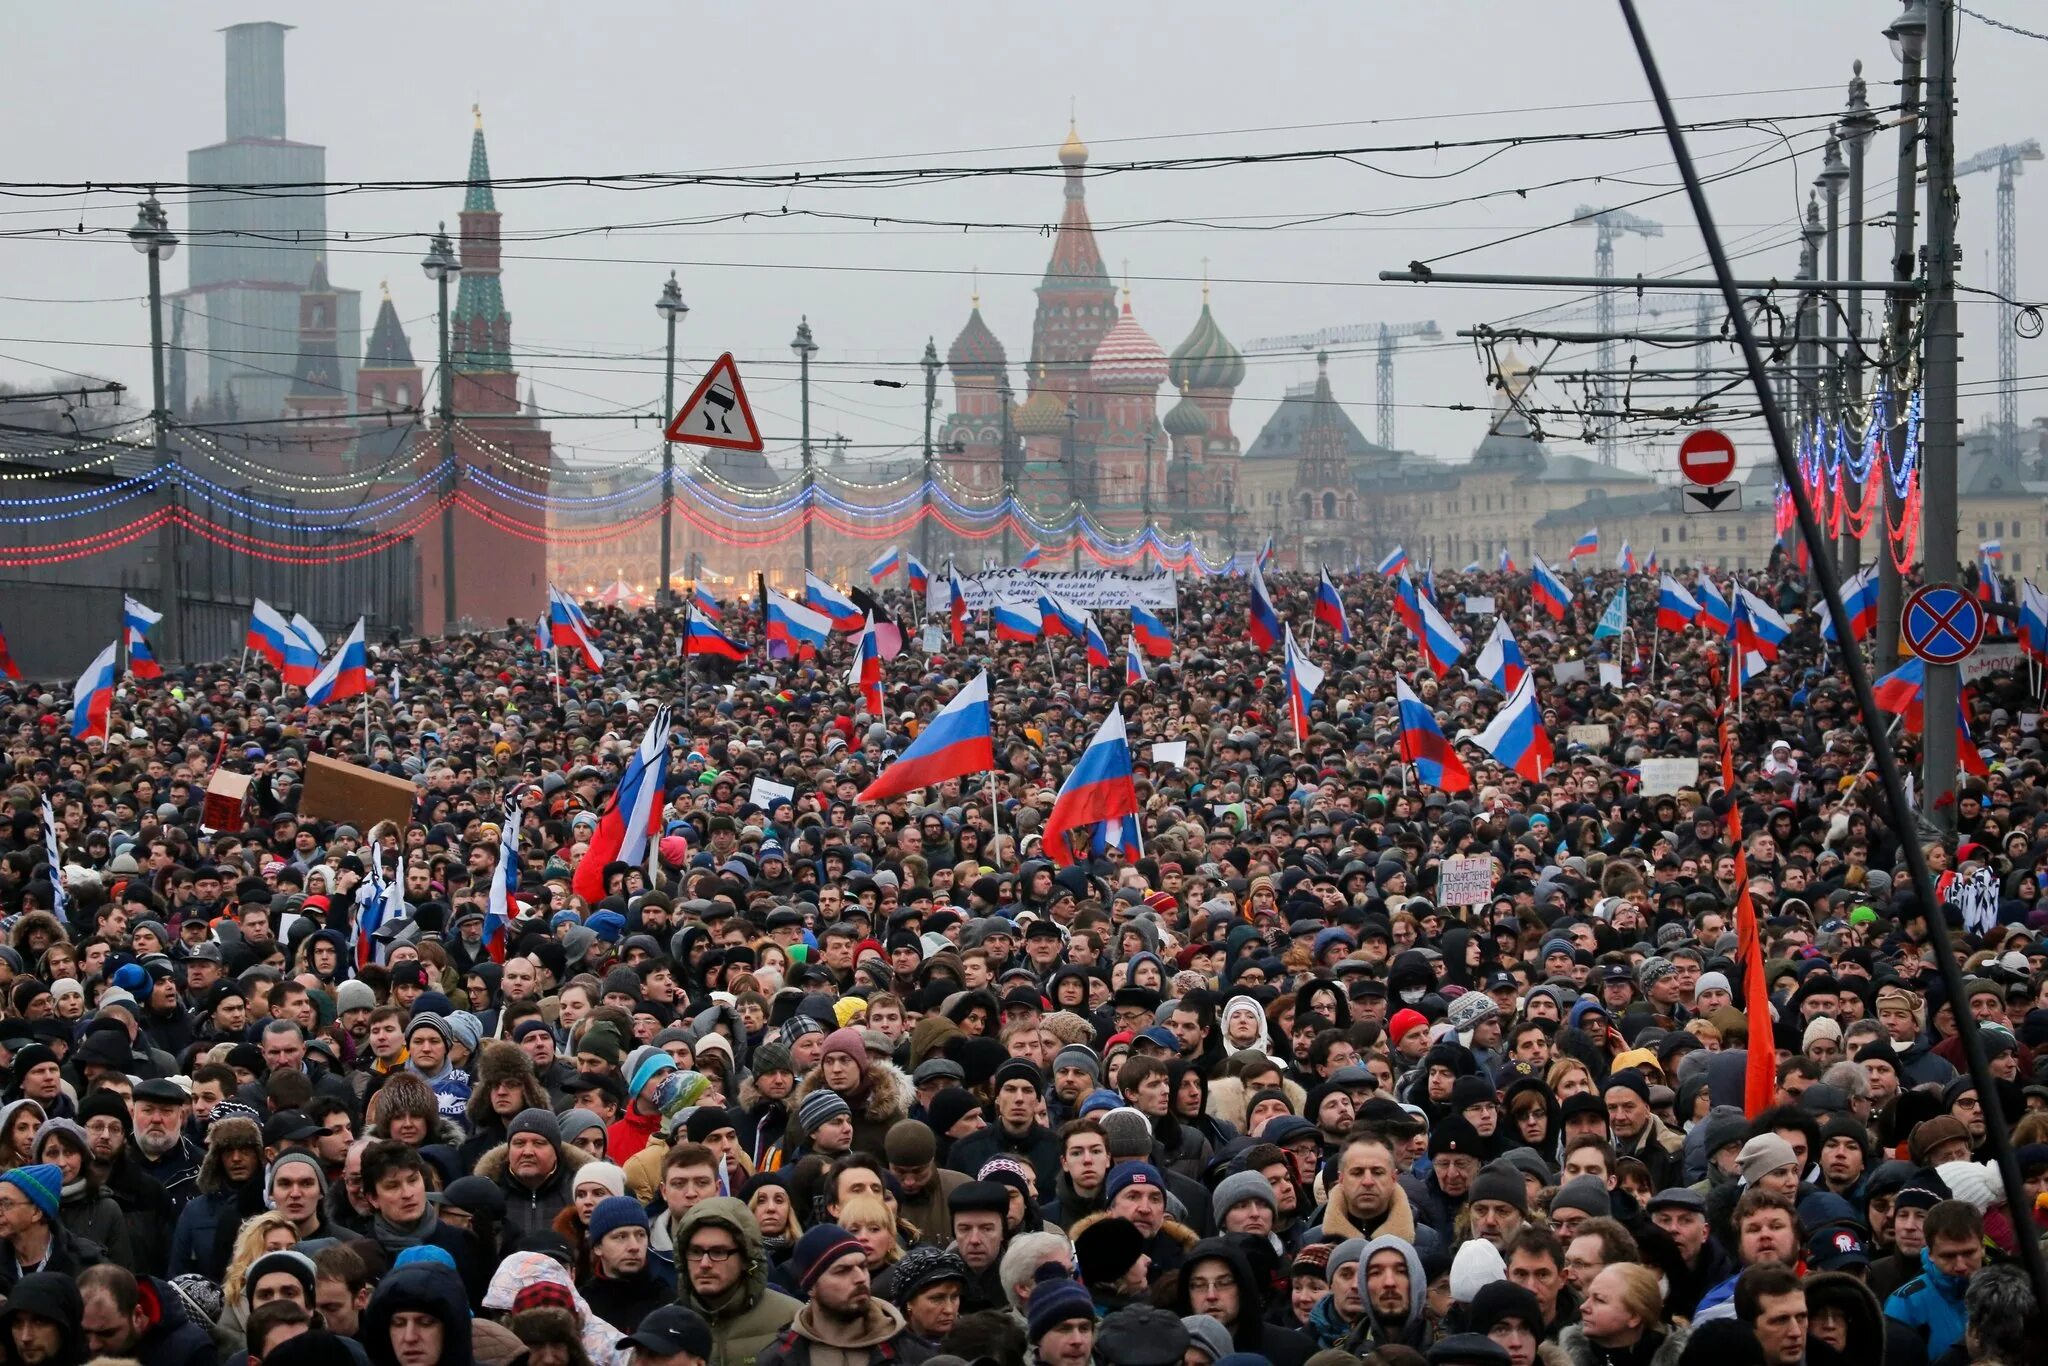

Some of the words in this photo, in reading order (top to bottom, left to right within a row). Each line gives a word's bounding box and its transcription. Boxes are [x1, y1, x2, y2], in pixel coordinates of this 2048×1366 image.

[935, 568, 1018, 583] КГРЕСС
[1027, 569, 1168, 582] ИНТЕЛЛИГЕНЦИИ
[1010, 580, 1050, 588] ПРОТВ
[1455, 859, 1476, 871] НЕТ
